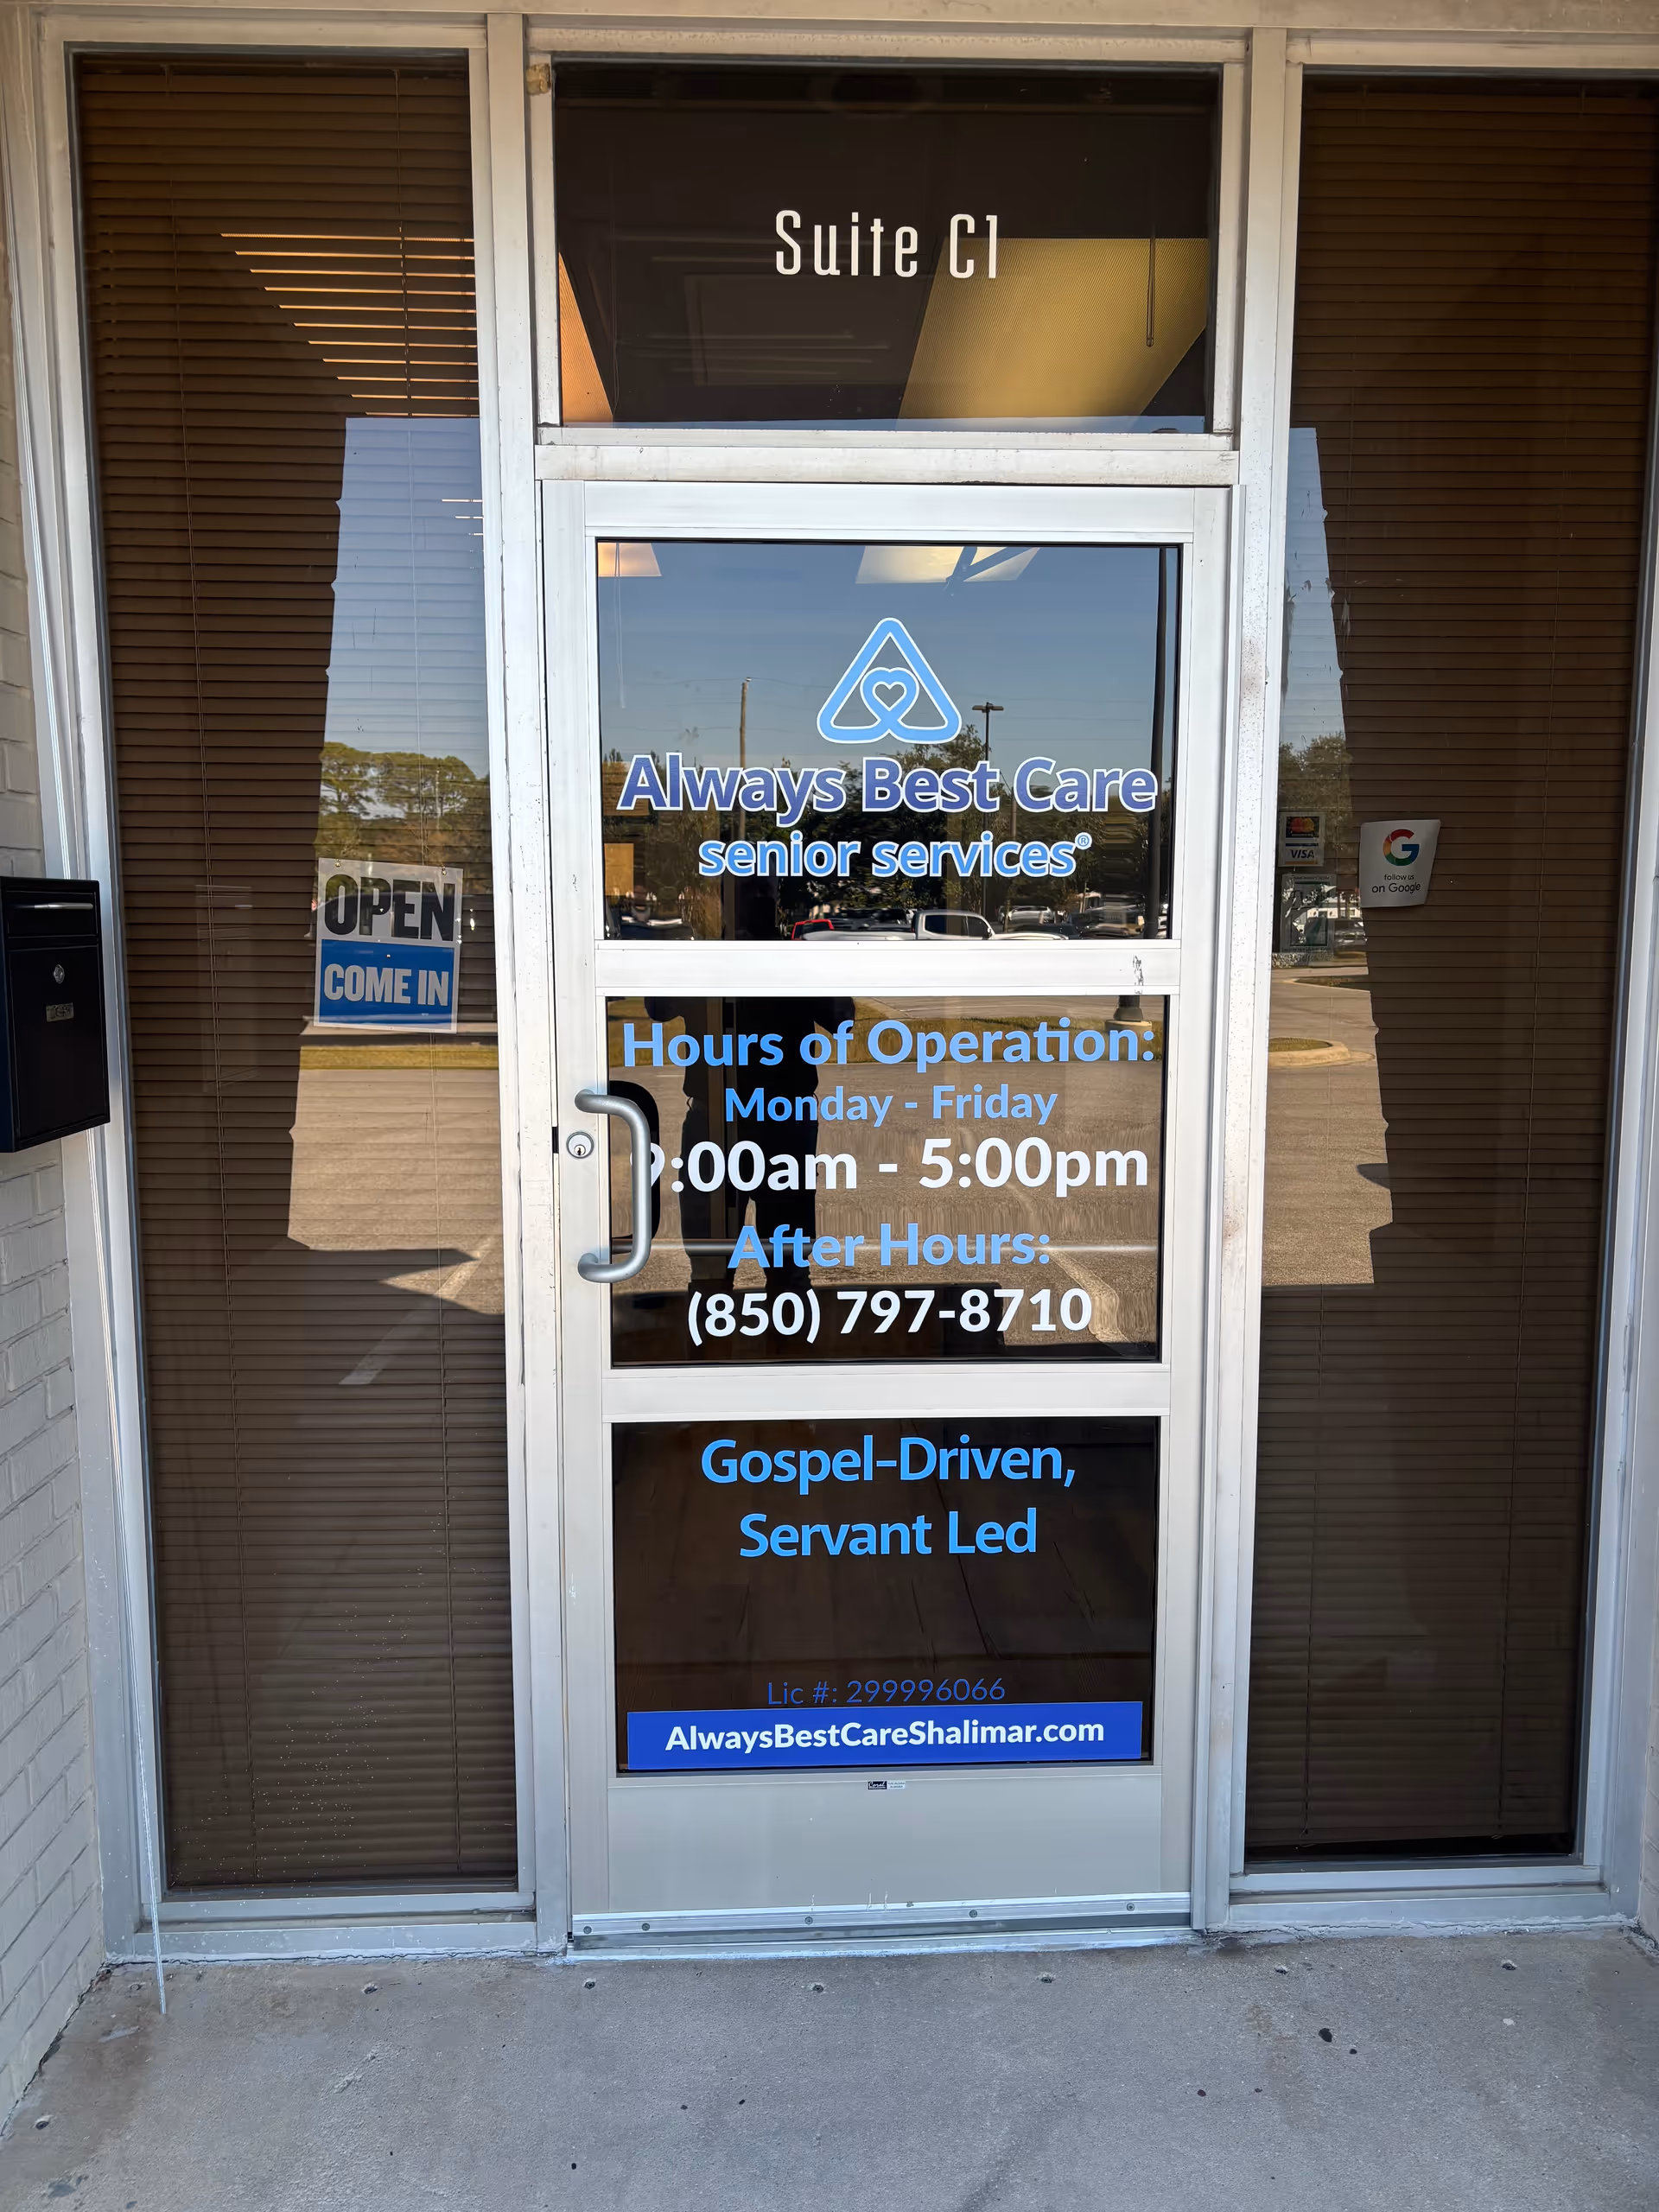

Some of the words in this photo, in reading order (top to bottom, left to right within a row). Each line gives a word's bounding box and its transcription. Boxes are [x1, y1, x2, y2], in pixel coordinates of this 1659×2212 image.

[775, 209, 918, 278] Suite
[949, 213, 999, 279] C1
[616, 752, 848, 827] Always
[861, 756, 1001, 812] Best
[1013, 756, 1159, 813] Care
[698, 830, 861, 877] senior
[1289, 849, 1315, 859] VISA
[324, 874, 456, 942] OPEN
[1389, 882, 1421, 893] Google
[323, 963, 412, 1004] COME
[417, 969, 449, 1007] IN
[623, 1022, 784, 1067] Hours
[799, 1020, 854, 1065] of
[868, 1017, 1154, 1073] Operation:
[725, 1086, 893, 1128] Monday
[932, 1084, 1058, 1125] Friday
[878, 1163, 898, 1173] -
[918, 1137, 1147, 1198] 5:00pm
[728, 1224, 864, 1268] After
[880, 1223, 1050, 1266] Hours:
[688, 1289, 821, 1346] (850)
[836, 1287, 1092, 1334] 797-8710
[701, 1433, 1076, 1496] Gospel-Driven,
[739, 1513, 932, 1557] Servant
[949, 1507, 1037, 1554] Led
[767, 1682, 804, 1705] Lic
[812, 1681, 837, 1703] #:
[846, 1678, 1006, 1704] 299996066
[665, 1719, 1105, 1754] AlwaysBestCareShalimar.com
